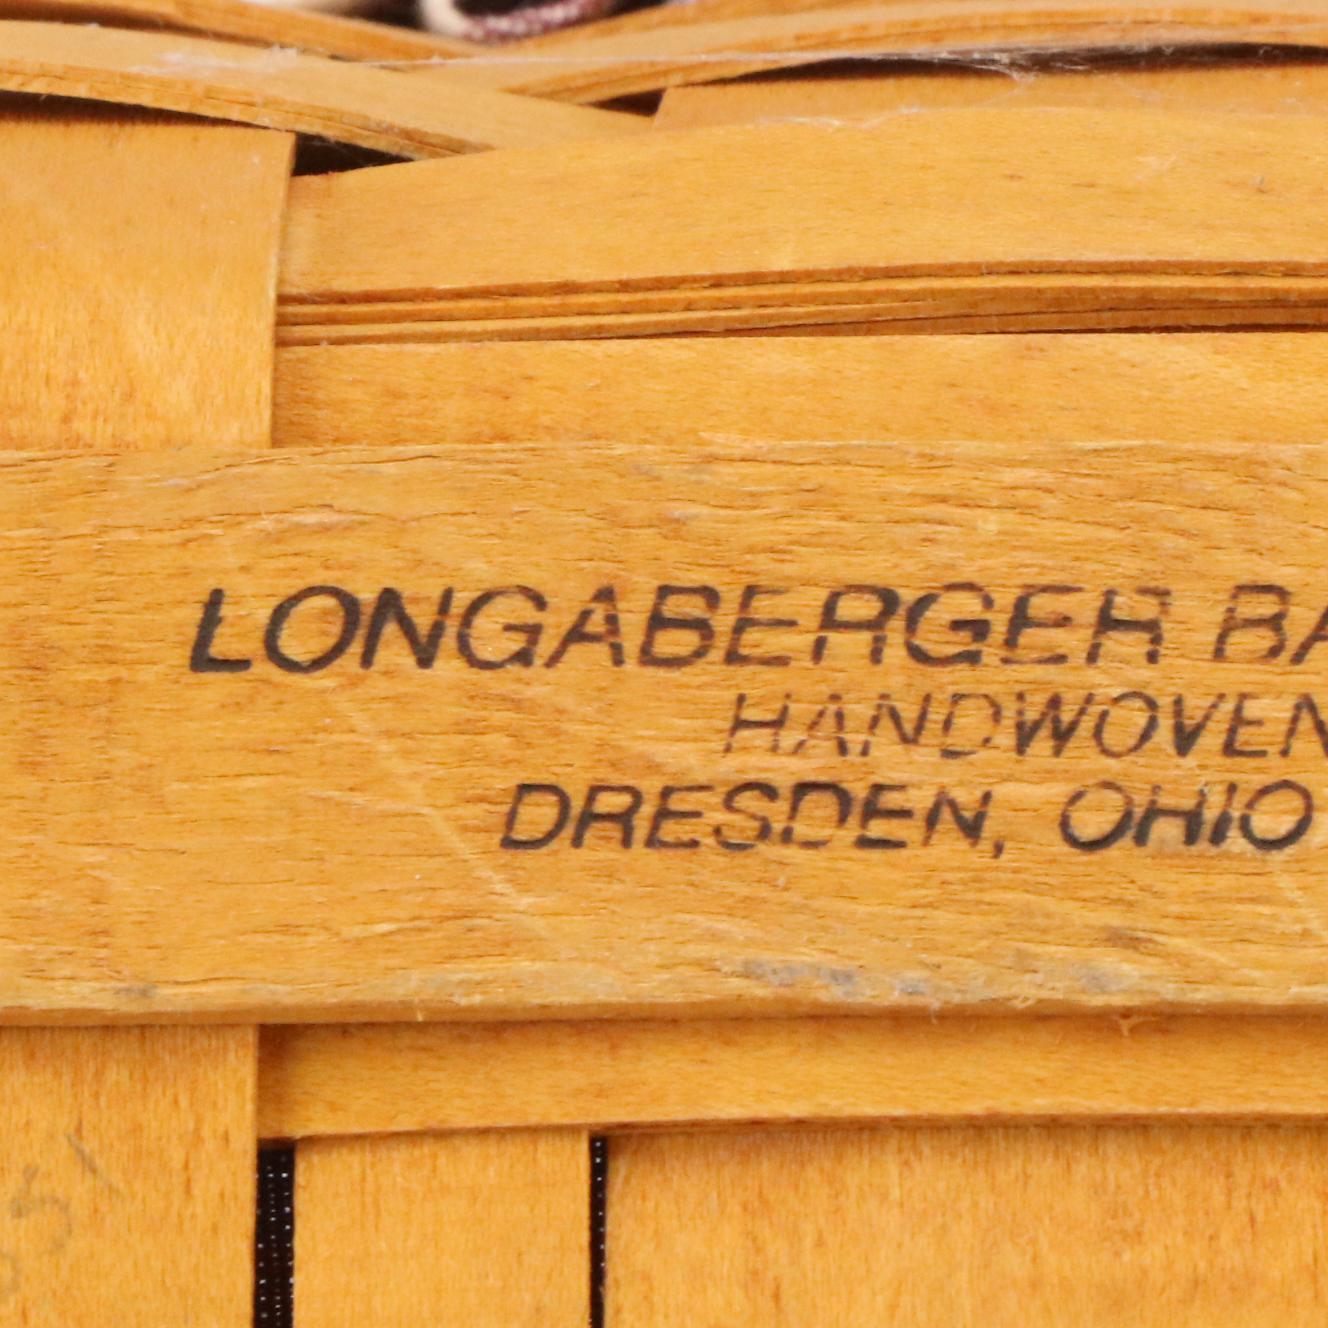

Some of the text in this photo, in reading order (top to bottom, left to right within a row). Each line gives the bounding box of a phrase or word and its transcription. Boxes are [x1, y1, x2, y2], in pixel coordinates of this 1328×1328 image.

[189, 583, 1173, 674] LONGABERGER
[500, 781, 1005, 860] DRESDEN,
[1060, 779, 1315, 852] OHIO
